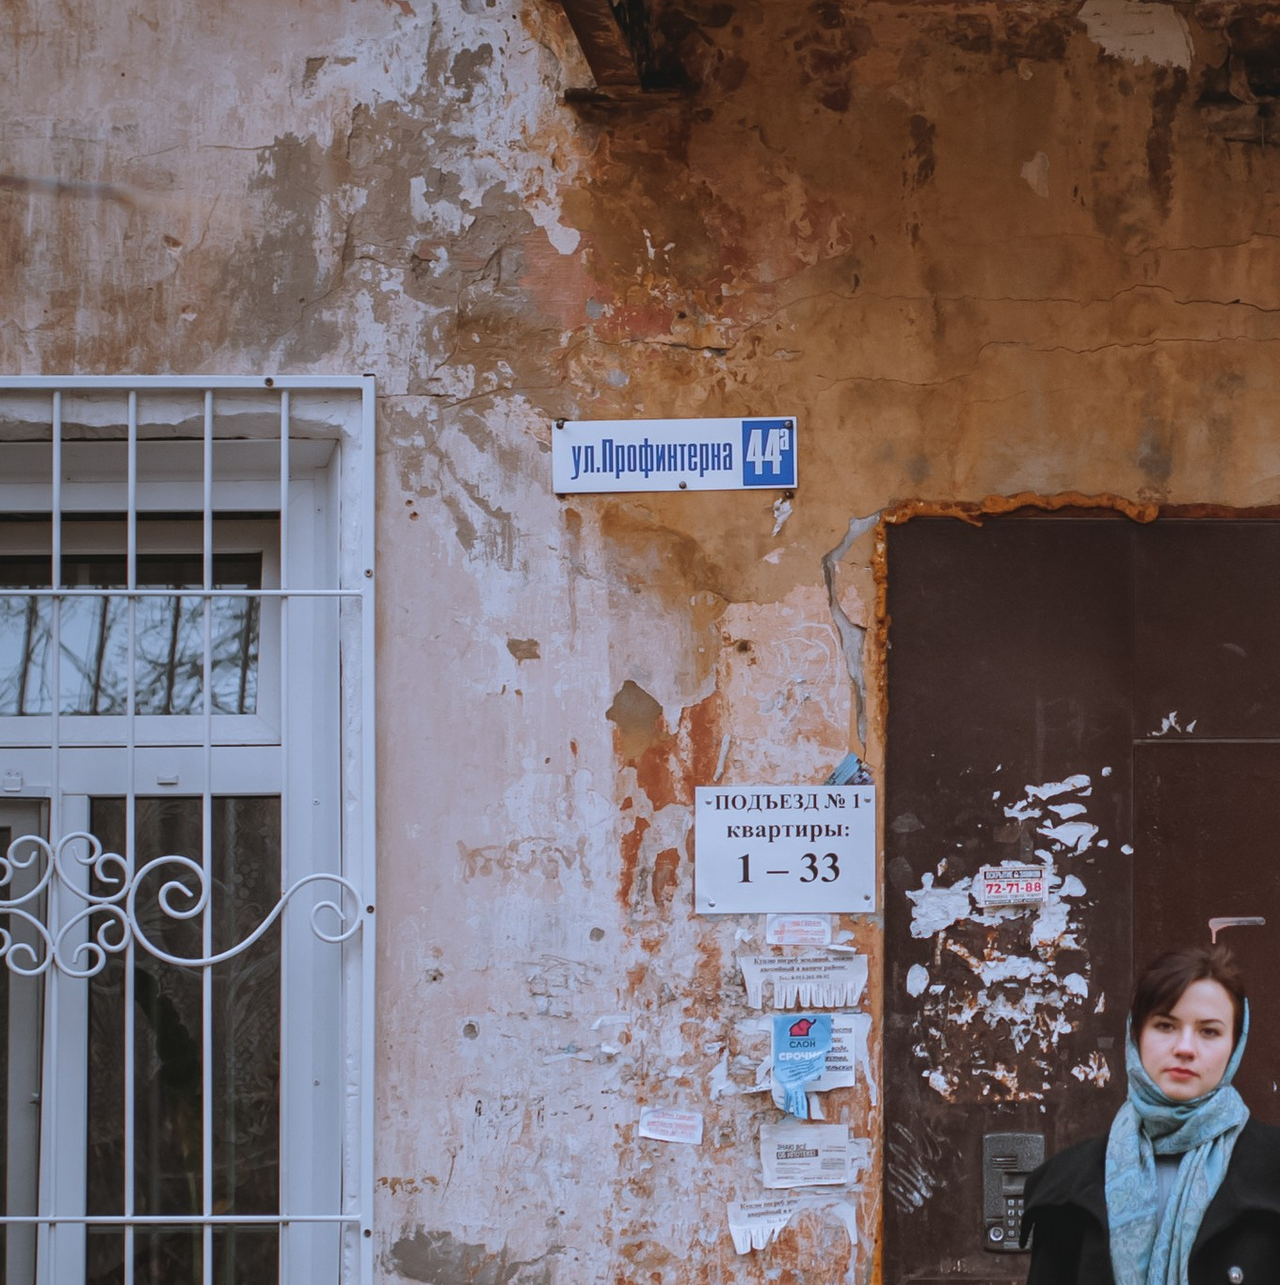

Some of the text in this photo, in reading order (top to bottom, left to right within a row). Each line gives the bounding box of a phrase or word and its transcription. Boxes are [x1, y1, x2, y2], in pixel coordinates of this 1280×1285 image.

[571, 438, 733, 480] ул.Профинтерна
[715, 793, 819, 812] ПОДЪЕЗД
[853, 793, 860, 808] 1
[727, 824, 850, 843] квартиры:
[737, 853, 753, 883] 1
[799, 852, 840, 883] 33
[986, 882, 1041, 893] 72-71-88
[789, 1040, 816, 1048] СЛОН
